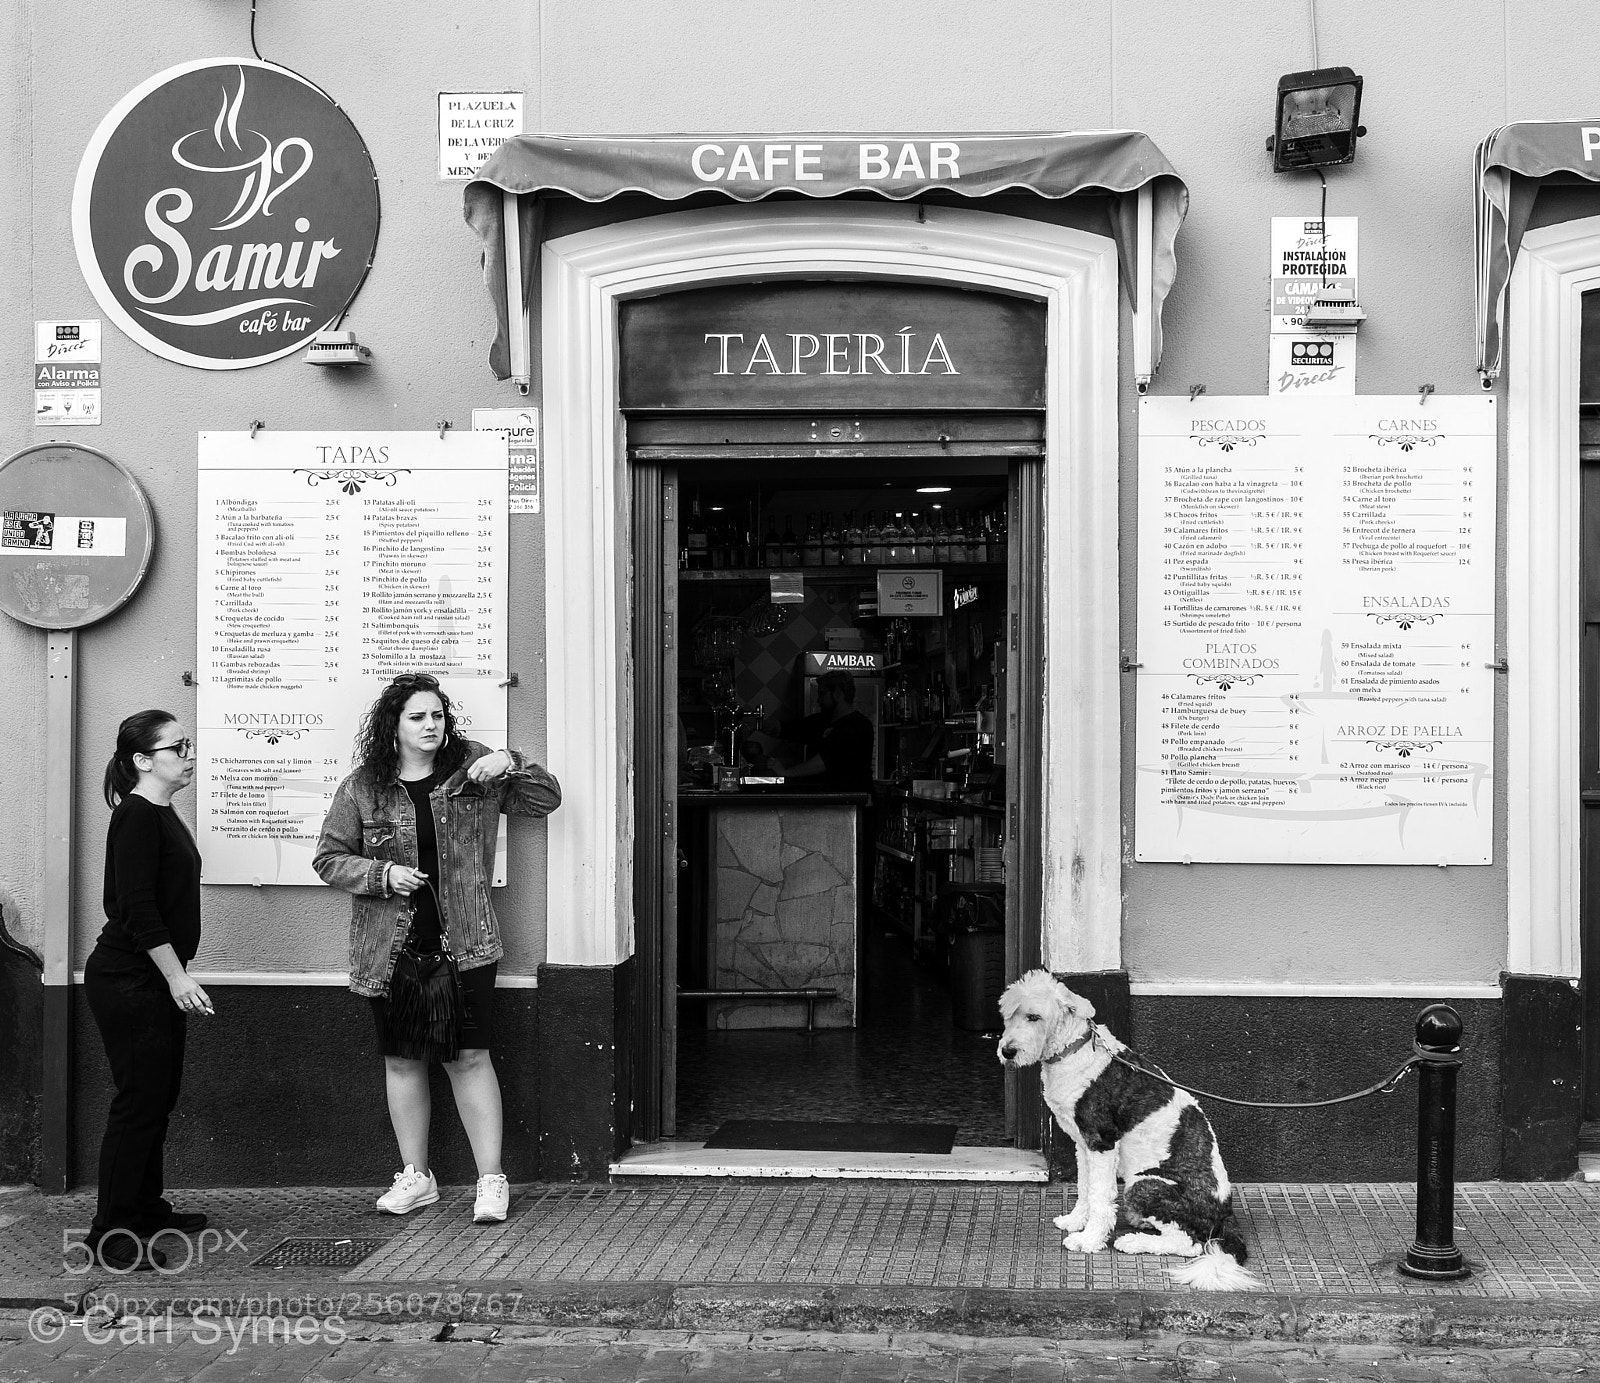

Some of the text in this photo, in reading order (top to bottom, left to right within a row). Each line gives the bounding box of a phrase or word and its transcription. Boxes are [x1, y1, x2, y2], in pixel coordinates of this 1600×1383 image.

[448, 101, 516, 110] PLAZUELA
[451, 119, 514, 128] DE LA CRUZ
[448, 138, 462, 146] DE
[465, 138, 479, 146] LA
[691, 142, 961, 181] CAFE BAR
[123, 187, 342, 304] Samir
[1283, 248, 1346, 261] INSTALACIÓN
[1283, 263, 1347, 275] PROTEGIDA
[1276, 297, 1286, 305] DE
[239, 310, 311, 335] café bar
[47, 339, 92, 358] Direct
[704, 326, 961, 375] TAPERÍA
[38, 366, 99, 380] Alarma
[1278, 366, 1345, 392] Direct
[1192, 420, 1265, 431] PESCADOS
[1378, 420, 1437, 431] CARNES
[316, 446, 389, 463] TAPAS
[1205, 466, 1232, 475] plancha
[221, 499, 258, 507] Albóndigas
[410, 545, 445, 553] langostino
[1185, 558, 1208, 566] espada
[220, 569, 256, 577] Chipirones
[1363, 596, 1450, 608] ENSALADAS
[371, 622, 419, 630] Saltimbonquis
[1206, 643, 1257, 654] PLATOS
[828, 654, 875, 667] AMBAR
[1183, 658, 1279, 669] COMBINADOS
[220, 676, 254, 684] Lagrimitas
[265, 676, 282, 684] pollo
[224, 713, 323, 725] MONTADITOS
[1337, 726, 1463, 736] ARROZ DE PAELLA
[1189, 754, 1216, 762] plancha
